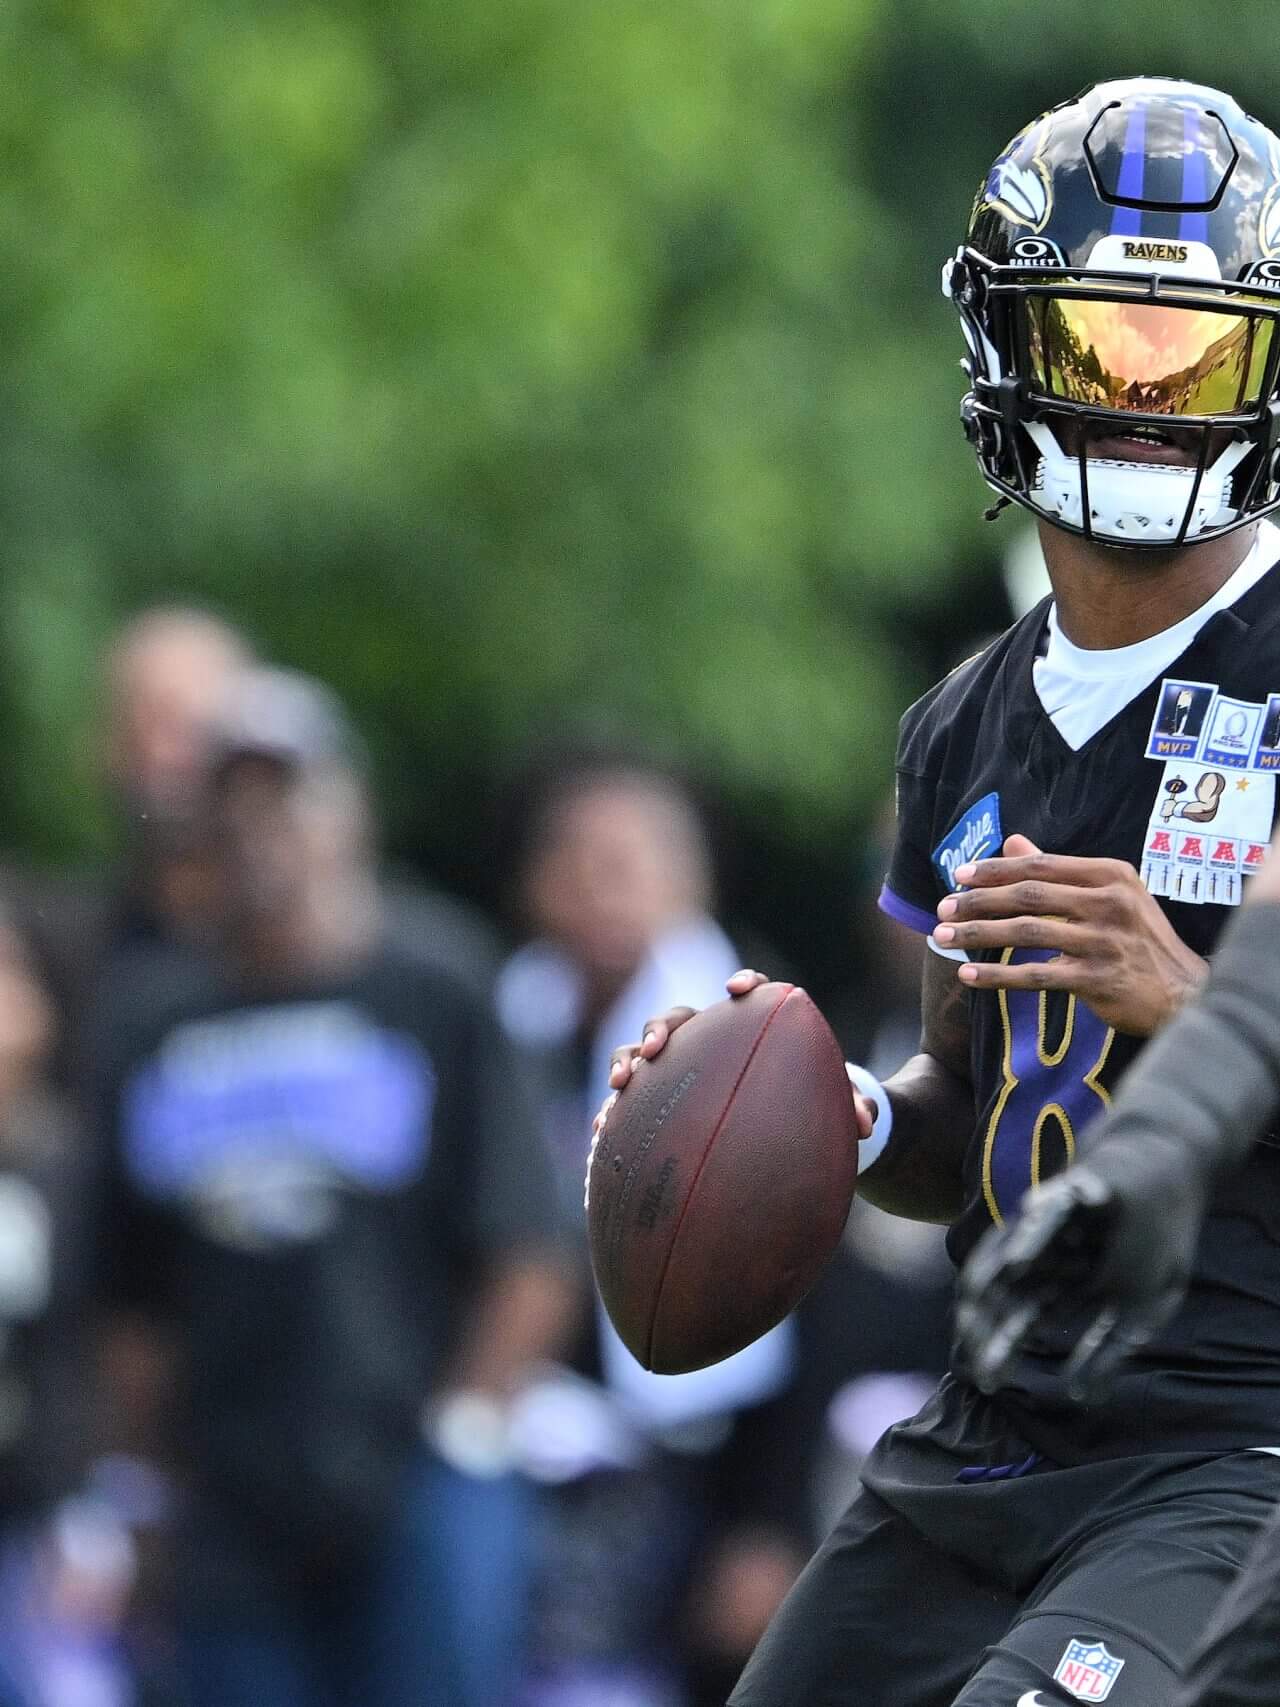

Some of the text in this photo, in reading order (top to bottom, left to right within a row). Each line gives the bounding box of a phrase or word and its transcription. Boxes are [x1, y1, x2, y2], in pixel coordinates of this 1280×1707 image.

[1009, 258, 1056, 267] OAKLEY
[1122, 242, 1188, 263] RAVENS
[1156, 740, 1191, 754] MVP
[940, 812, 992, 889] Perdue
[982, 915, 1116, 1232] 8
[1062, 1664, 1102, 1695] NFL
